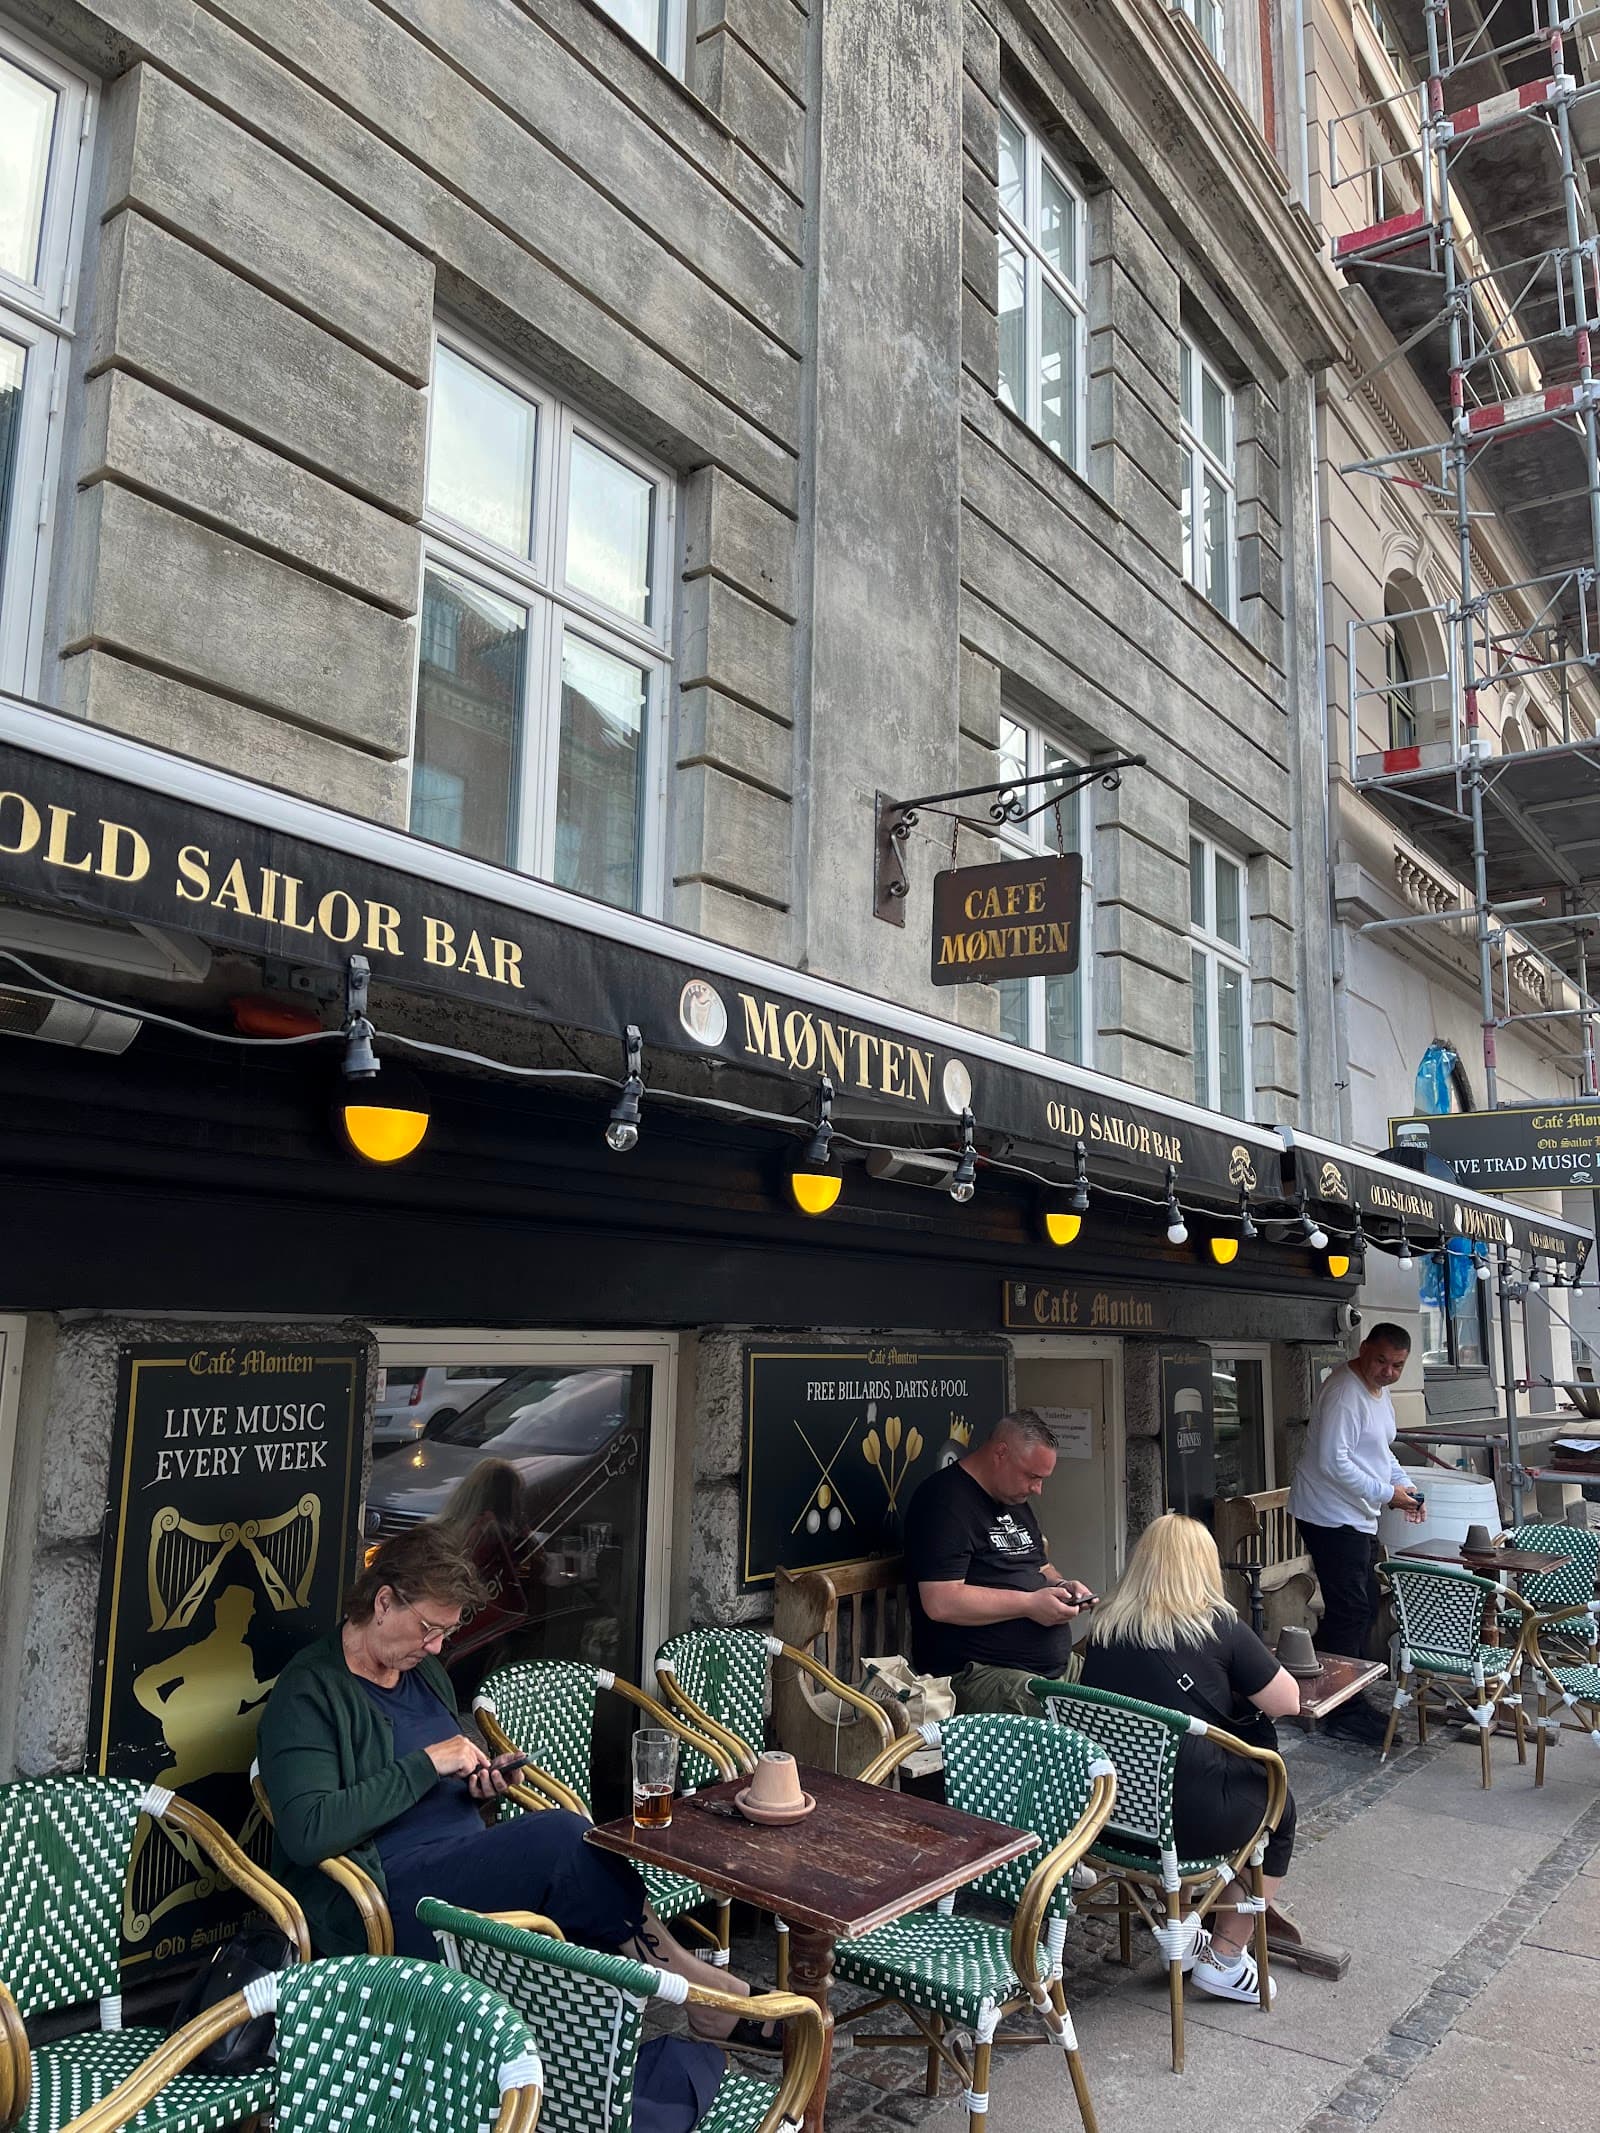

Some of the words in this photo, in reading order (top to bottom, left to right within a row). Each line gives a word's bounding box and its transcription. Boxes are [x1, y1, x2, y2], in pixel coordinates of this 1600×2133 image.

[0, 791, 151, 882] OLD
[176, 845, 404, 957] SAILOR
[423, 915, 525, 989] BAR
[937, 921, 1071, 965] MØNTEN
[737, 992, 934, 1105] MØNTEN
[1046, 1100, 1084, 1137] OLD
[1090, 1112, 1151, 1154] SAILOR
[1152, 1131, 1183, 1164] BAR
[1531, 1113, 1564, 1130] Café
[1537, 1138, 1558, 1150] Old
[1560, 1137, 1593, 1149] Sailor
[1446, 1158, 1480, 1174] IVE
[1484, 1156, 1527, 1173] TRAD
[1531, 1153, 1591, 1170] MUSIC
[1033, 1288, 1078, 1324] Café
[188, 1348, 235, 1375] Café
[806, 1381, 836, 1401] FREE
[838, 1379, 893, 1401] BILLARDS,
[895, 1380, 929, 1398] DARTS
[931, 1380, 938, 1398] &
[940, 1379, 969, 1398] POOL
[164, 1407, 228, 1439] LIVE
[234, 1402, 326, 1436] MUSIC
[154, 1445, 247, 1482] EVERY
[254, 1440, 329, 1473] WEEK
[154, 1935, 187, 1961] Old
[190, 1919, 239, 1952] Sailor
